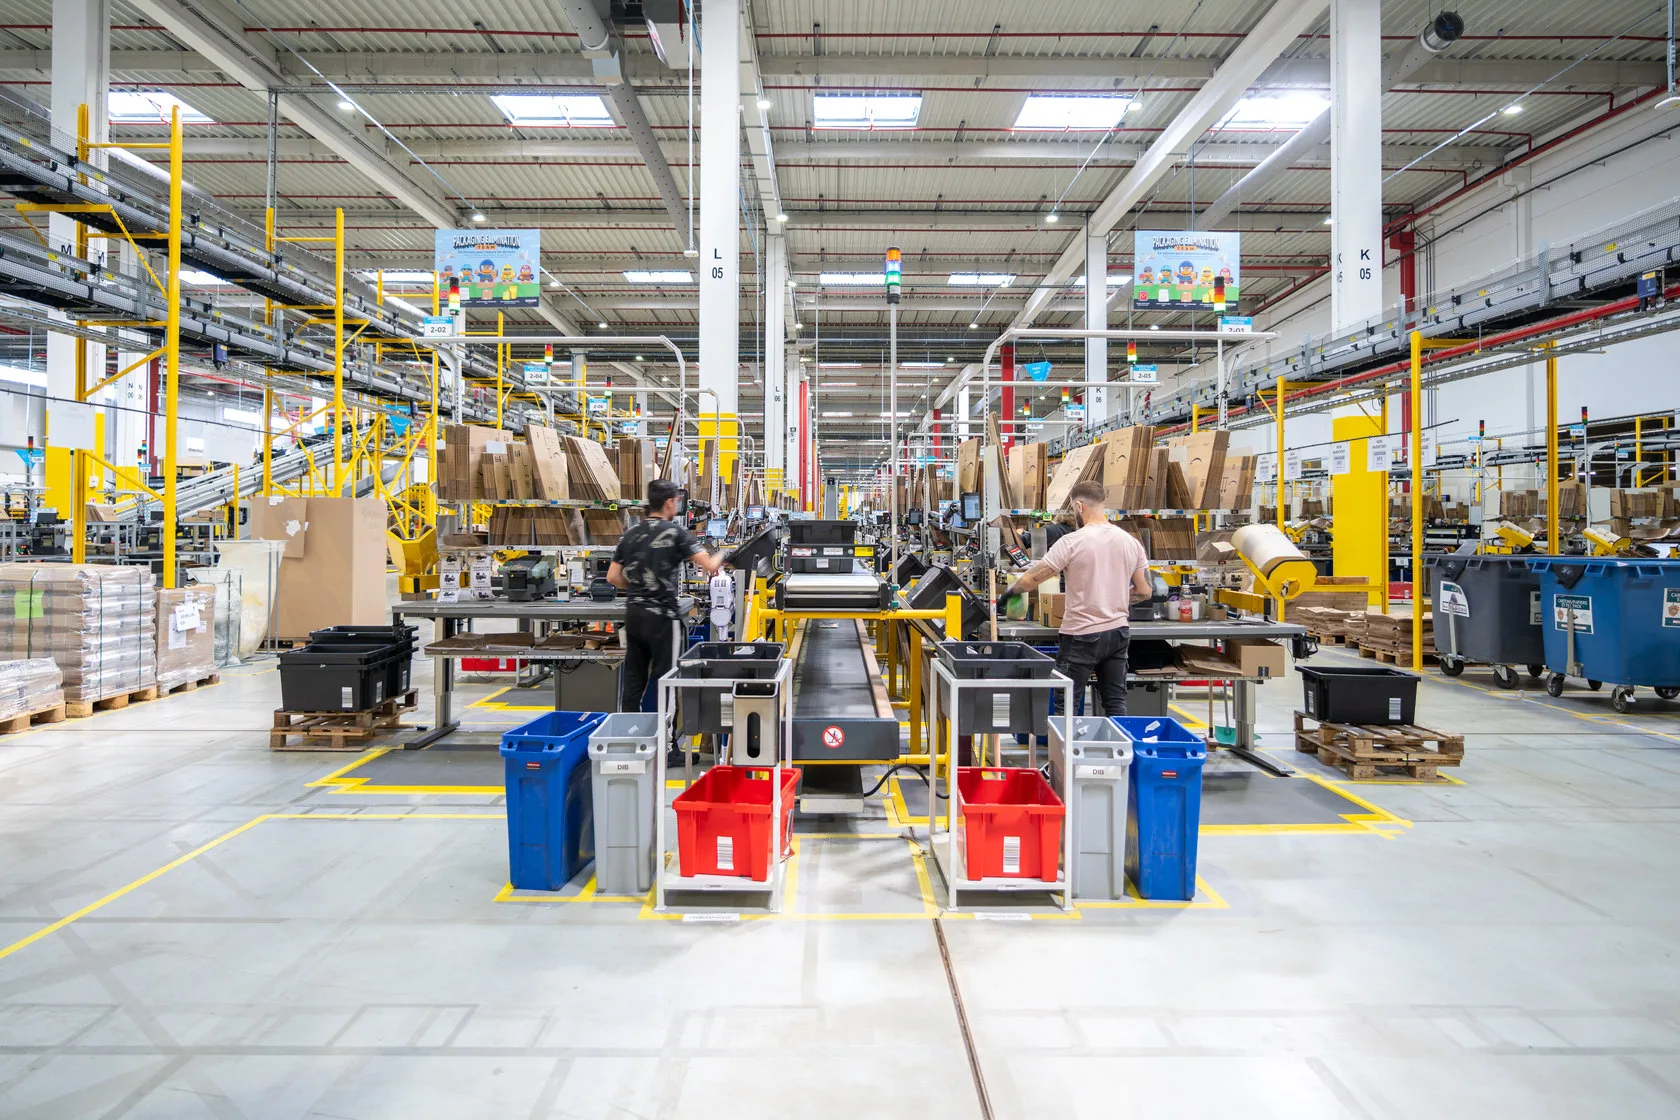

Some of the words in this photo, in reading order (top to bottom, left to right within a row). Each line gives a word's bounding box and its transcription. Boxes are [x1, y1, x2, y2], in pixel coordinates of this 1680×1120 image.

[453, 234, 484, 250] PACKAGING
[485, 234, 520, 250] ELIMINATION
[1152, 235, 1184, 251] PACKAGING
[1185, 236, 1220, 252] ELIMINATION
[61, 244, 72, 255] M
[714, 248, 722, 260] L
[1361, 249, 1370, 260] K
[712, 267, 724, 280] 05
[1360, 268, 1371, 280] 05
